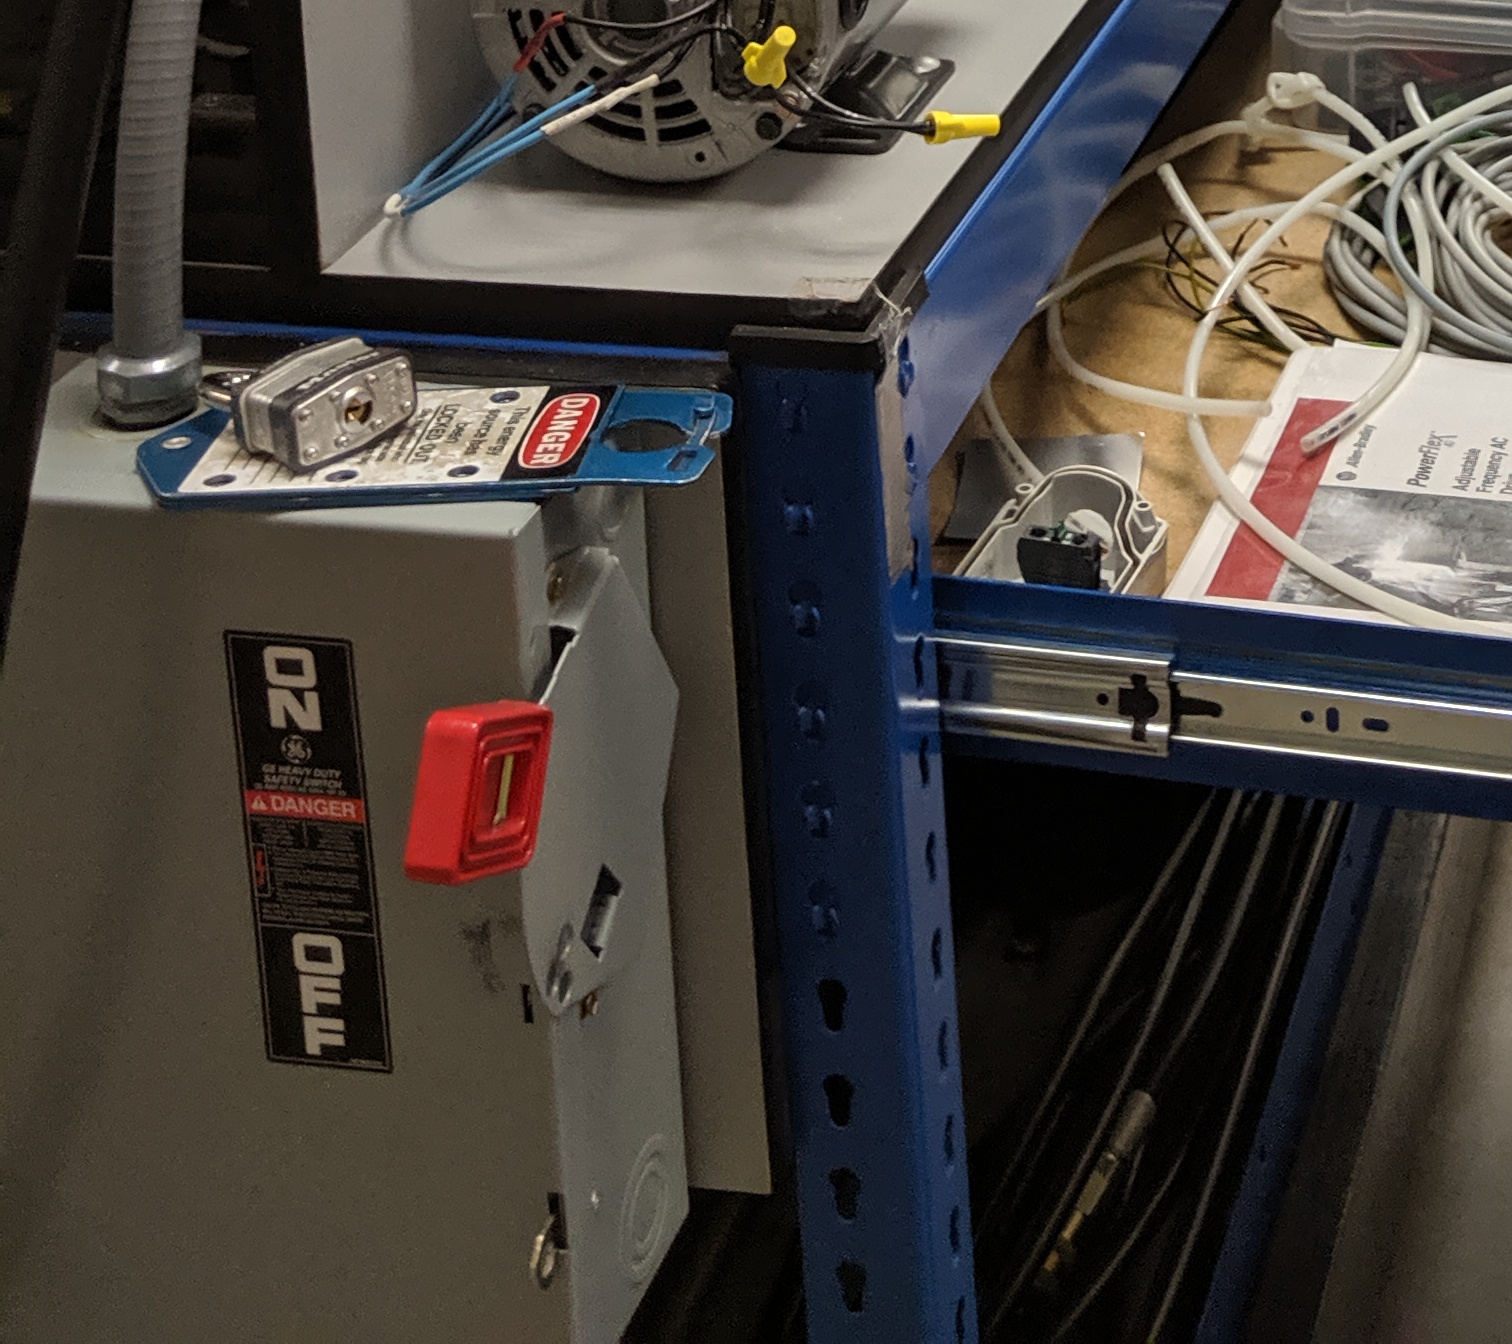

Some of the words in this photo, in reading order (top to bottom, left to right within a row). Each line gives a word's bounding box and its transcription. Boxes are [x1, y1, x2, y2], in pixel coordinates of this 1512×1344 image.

[426, 404, 460, 441] LOCKED
[474, 409, 501, 438] source
[506, 405, 531, 425] This
[530, 396, 590, 465] DANGER
[446, 422, 472, 444] been
[485, 426, 517, 457] energy
[1346, 424, 1377, 468] Allen-Bradley
[1490, 436, 1509, 450] AC
[1452, 448, 1481, 491] Adjustable
[1476, 450, 1509, 493] Frequency
[263, 645, 323, 731] ON
[264, 774, 301, 786] SAFETY
[278, 764, 312, 777] HEAVY
[313, 767, 342, 779] DUTY
[271, 795, 356, 818] DANGER
[292, 932, 346, 1056] OFF
